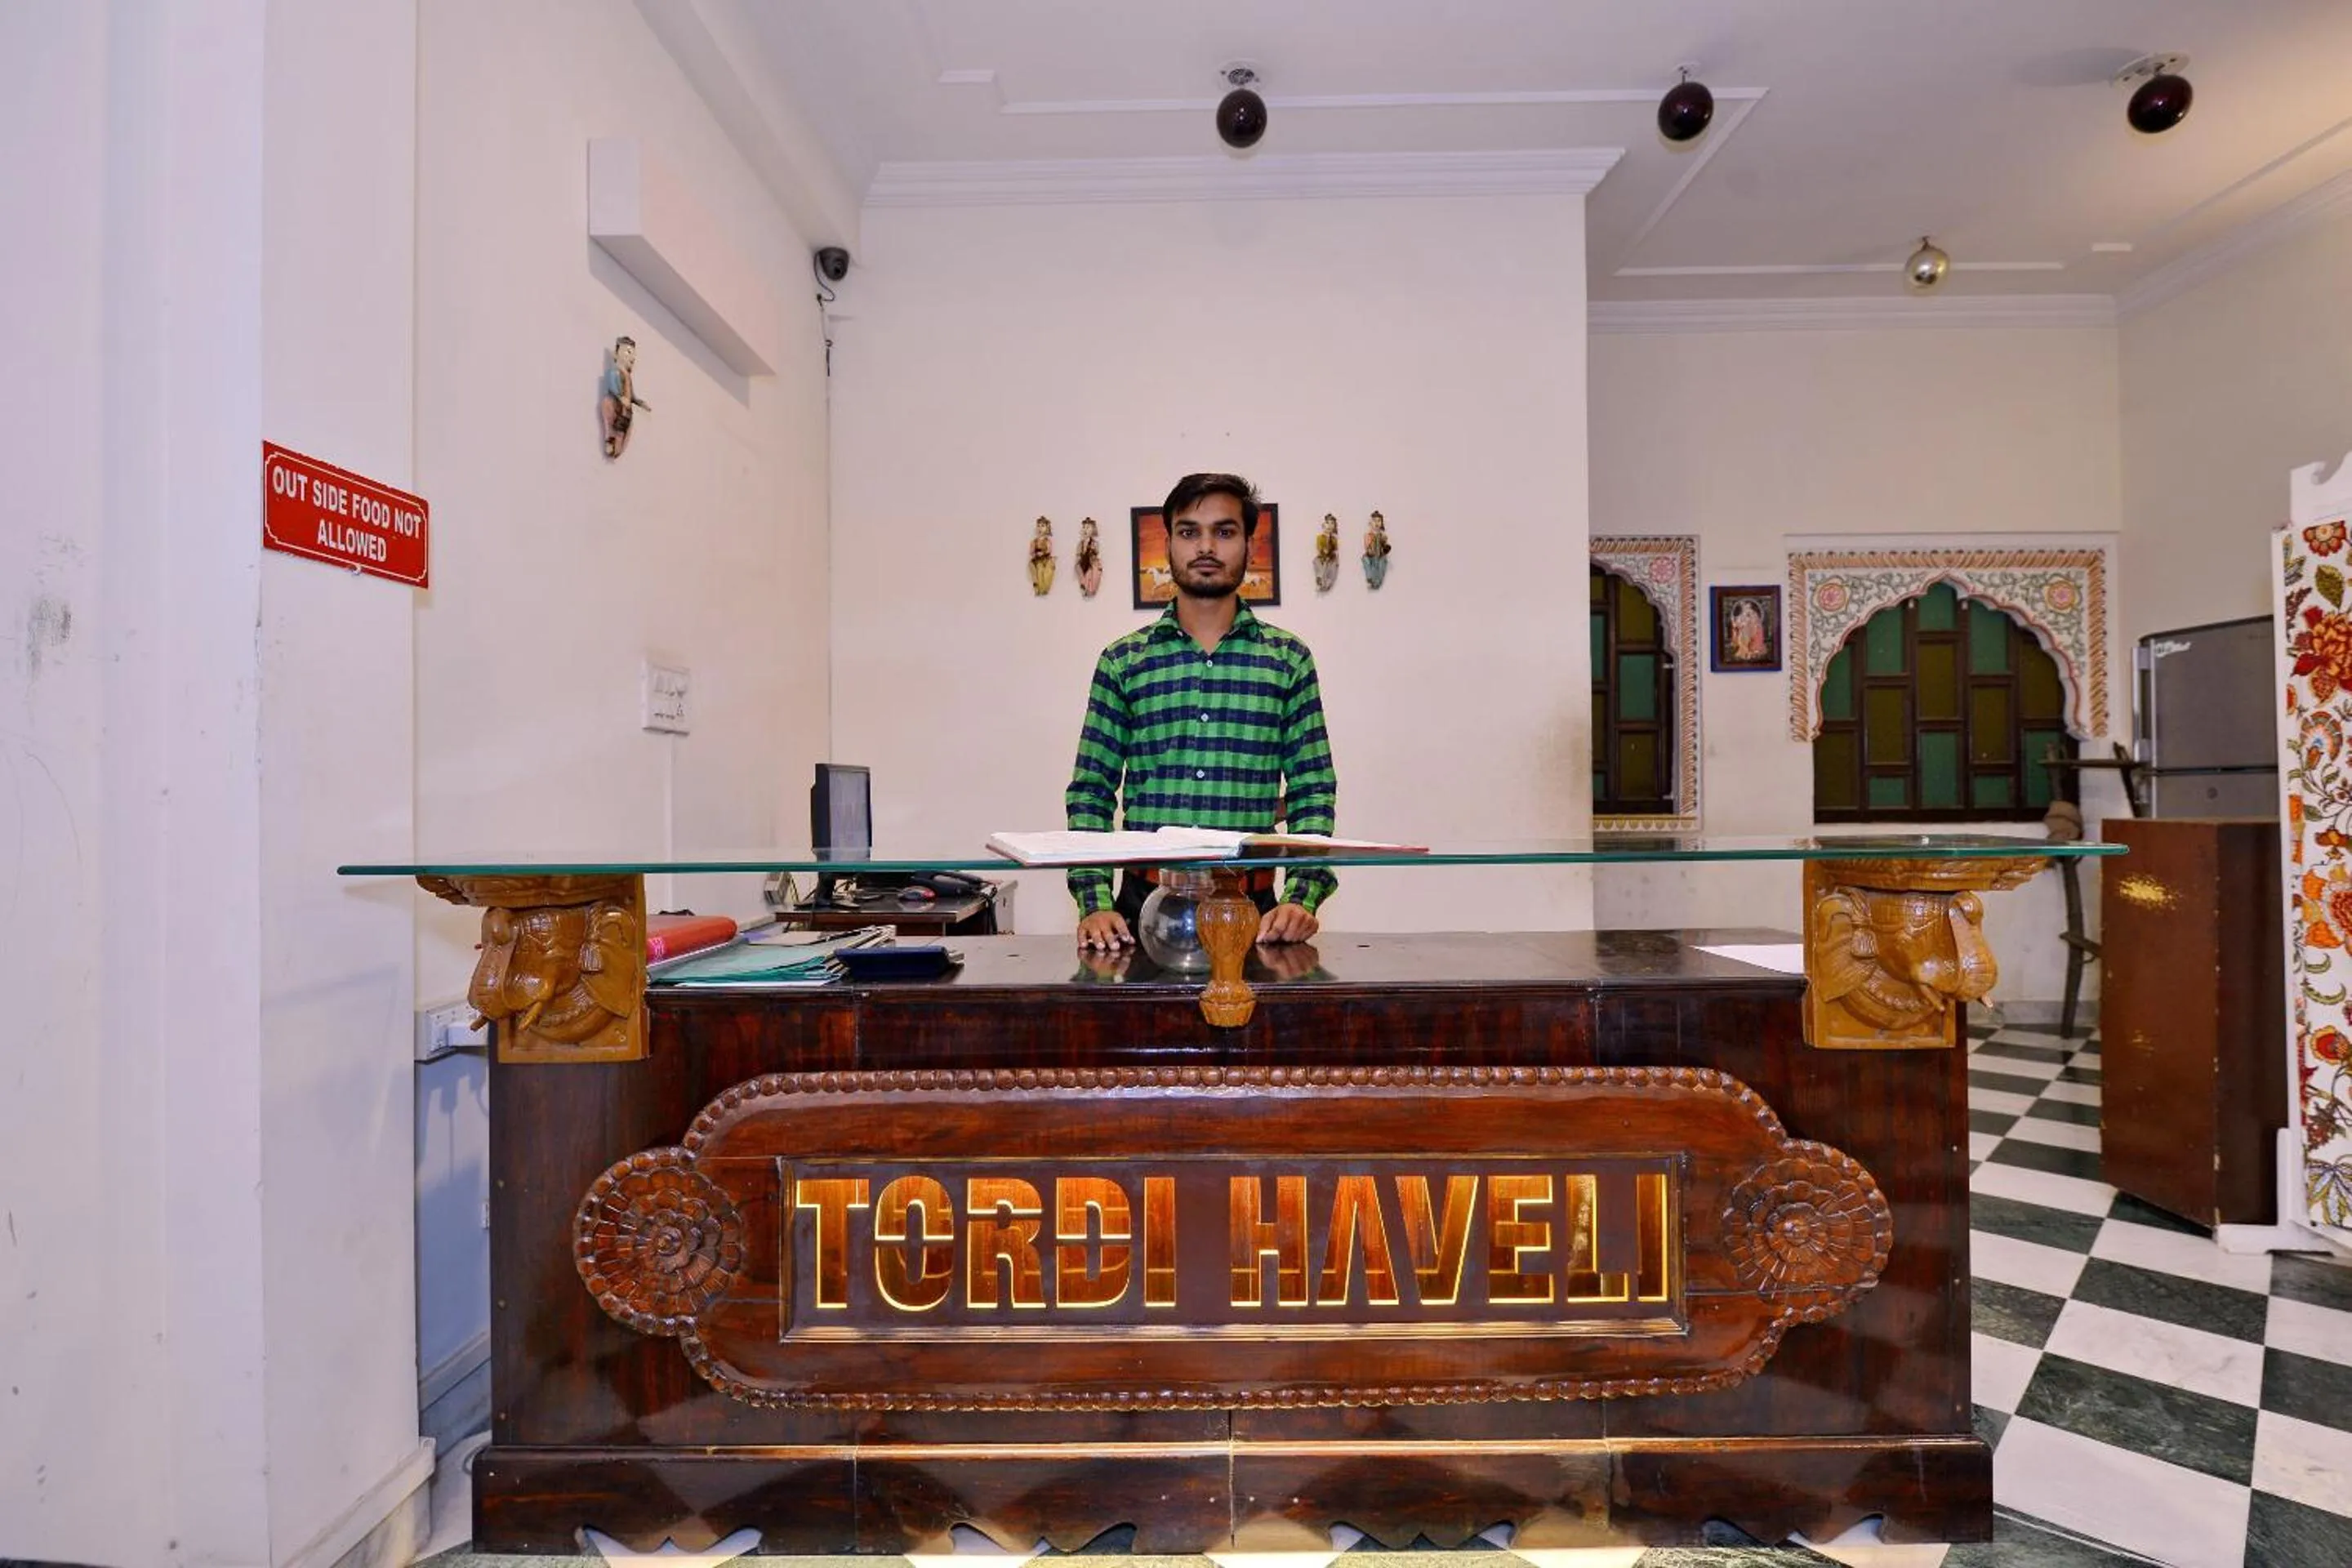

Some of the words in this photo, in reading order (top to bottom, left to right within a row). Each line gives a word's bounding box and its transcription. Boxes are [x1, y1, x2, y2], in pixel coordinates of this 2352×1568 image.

[273, 466, 308, 501] OUT
[313, 479, 347, 515] SIDE
[352, 493, 390, 528] FOOD
[394, 508, 421, 538] NOT
[318, 519, 387, 563] ALLOWED
[795, 1176, 1176, 1312] TORDI
[1230, 1174, 1668, 1307] HAVELI
